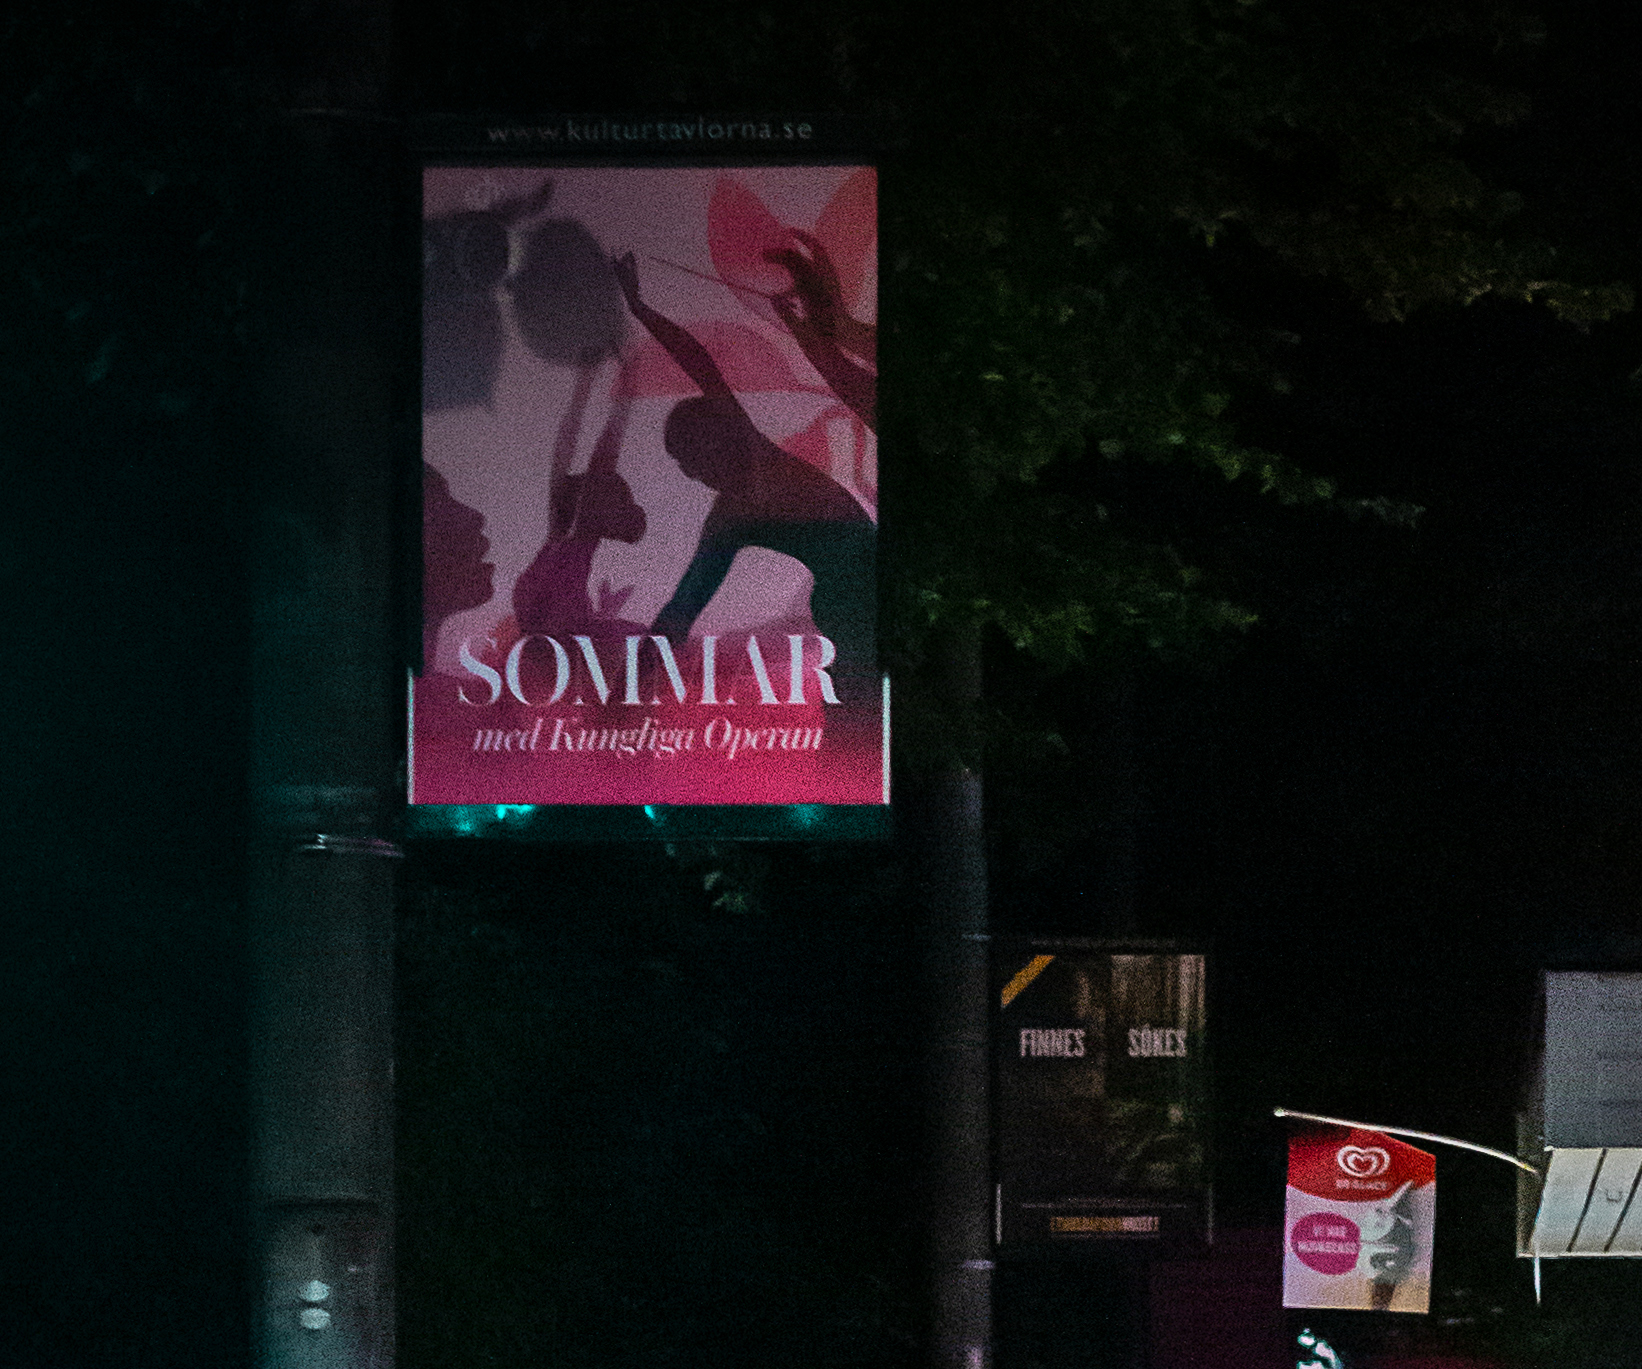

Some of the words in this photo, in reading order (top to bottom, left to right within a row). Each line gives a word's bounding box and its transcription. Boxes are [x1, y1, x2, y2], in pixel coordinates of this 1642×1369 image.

[486, 117, 814, 142] www.kulturtavlorna.se
[458, 634, 841, 707] SOMMAR
[473, 717, 541, 752] med
[548, 717, 696, 759] Kungliga
[703, 717, 824, 760] Operan
[1020, 1028, 1086, 1058] FINNES
